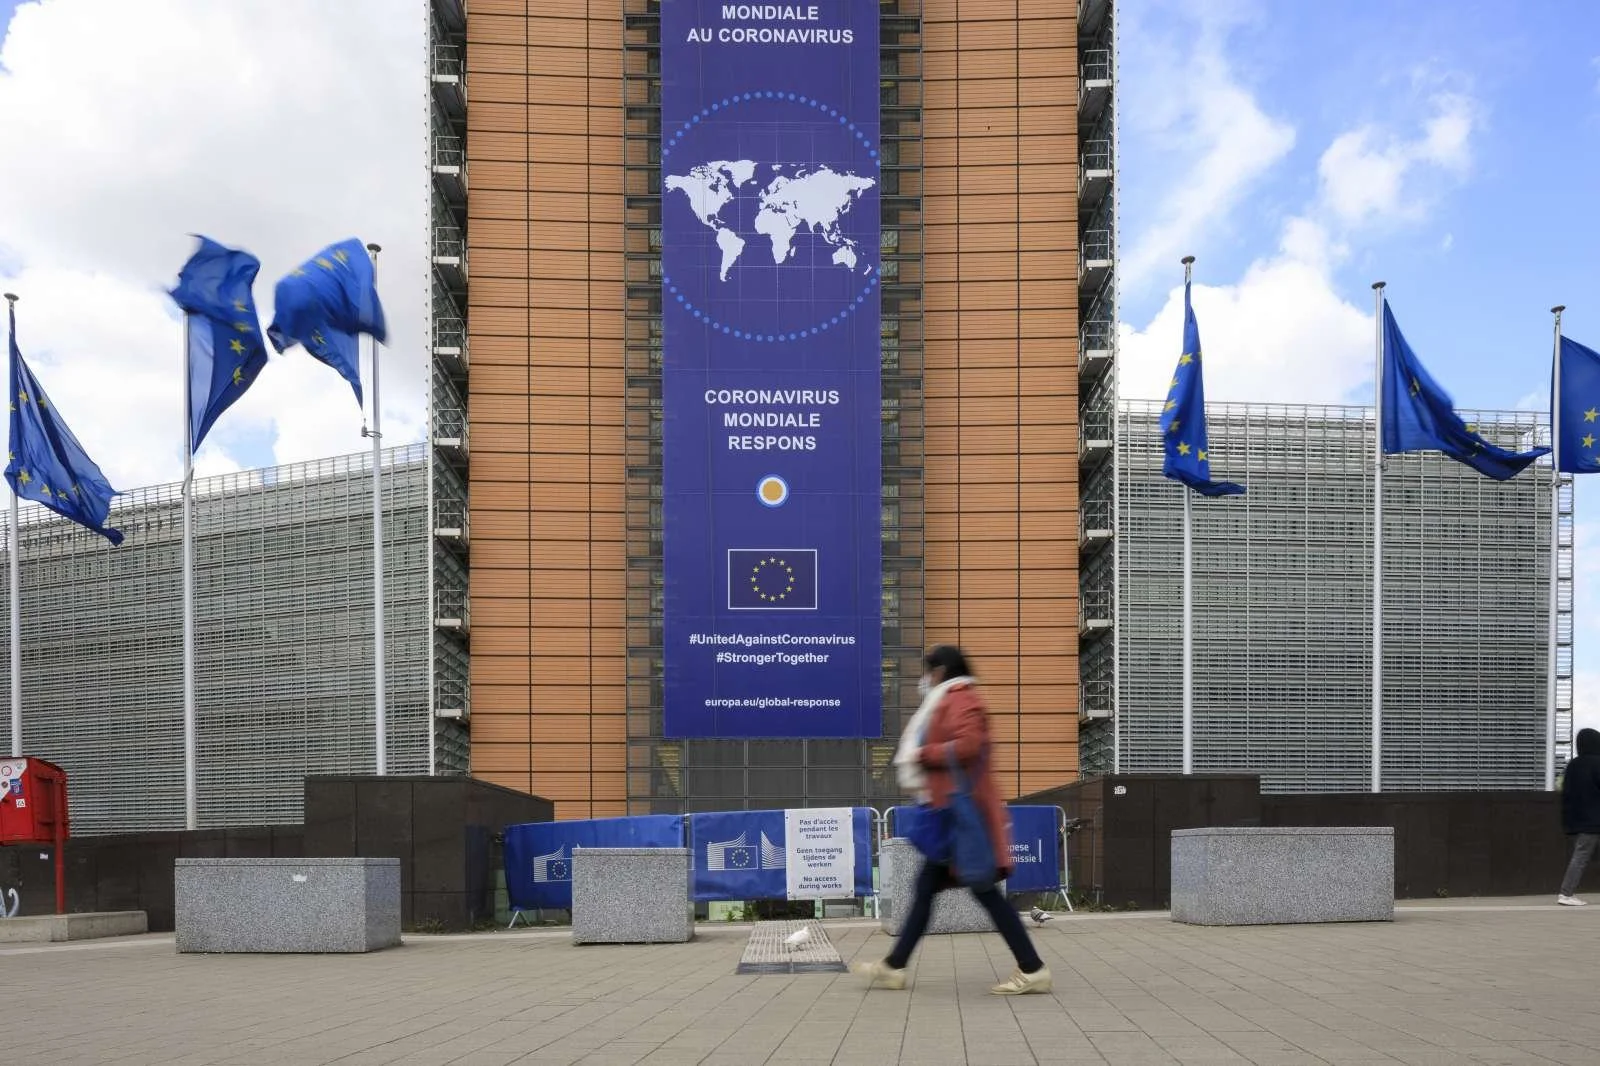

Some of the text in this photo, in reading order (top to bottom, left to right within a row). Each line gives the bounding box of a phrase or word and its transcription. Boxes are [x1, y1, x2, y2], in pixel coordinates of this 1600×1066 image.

[722, 5, 819, 20] MONDIALE
[687, 28, 854, 44] AU CORONAVIRUS
[704, 390, 840, 405] CORONAVIRUS
[724, 413, 821, 427] MONDIALE
[728, 435, 817, 450] RESPONS
[689, 634, 856, 647] #UnitedAgainstCoronavirus
[716, 652, 829, 665] #StrongerTogether
[705, 697, 841, 709] europa.eu/global-response
